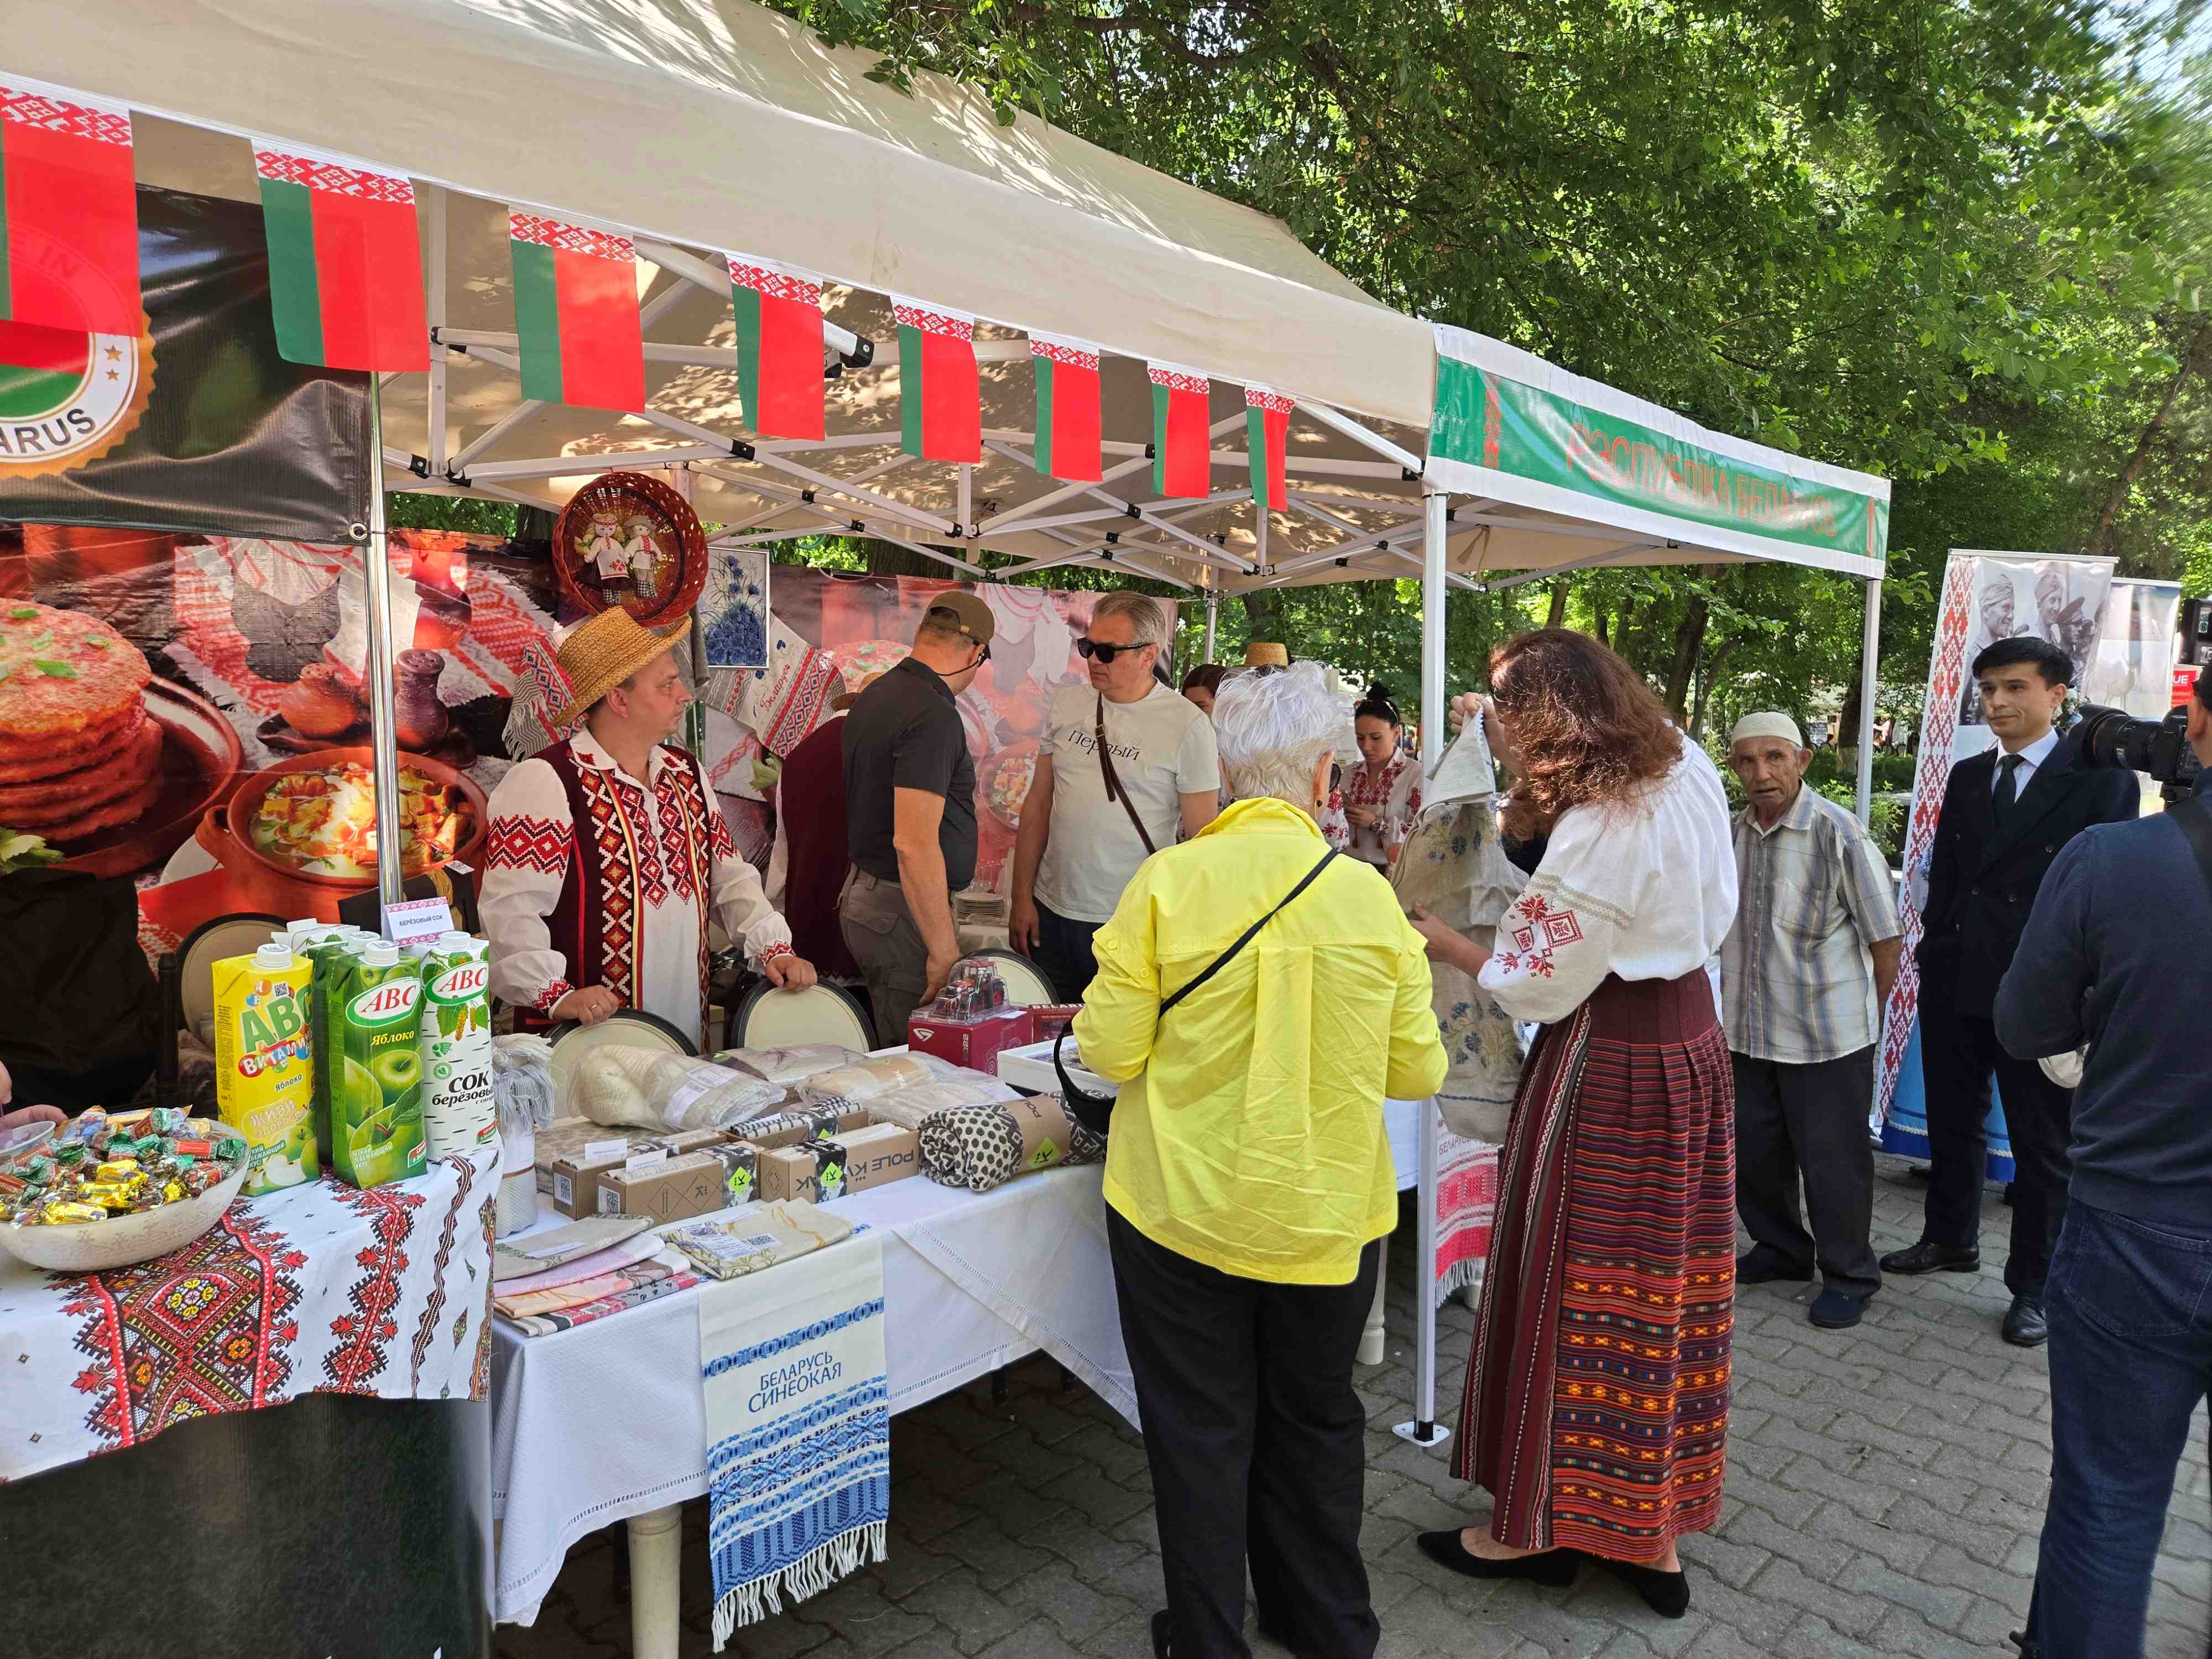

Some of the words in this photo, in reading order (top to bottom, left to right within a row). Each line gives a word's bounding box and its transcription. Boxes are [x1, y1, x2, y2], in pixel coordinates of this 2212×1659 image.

[1736, 473, 1838, 538] БЕЛАУСЬ
[399, 915, 432, 927] БЕРЁЗОВЫЙ
[437, 967, 487, 992] ABC
[360, 984, 417, 1013] ABC
[371, 1030, 415, 1046] Яблоко
[431, 1088, 494, 1108] берёзовы
[872, 1149, 914, 1172] POLE
[759, 1350, 833, 1391] БЕЛАРУСЬ
[748, 1361, 842, 1414] СИНЕОКАЯ
